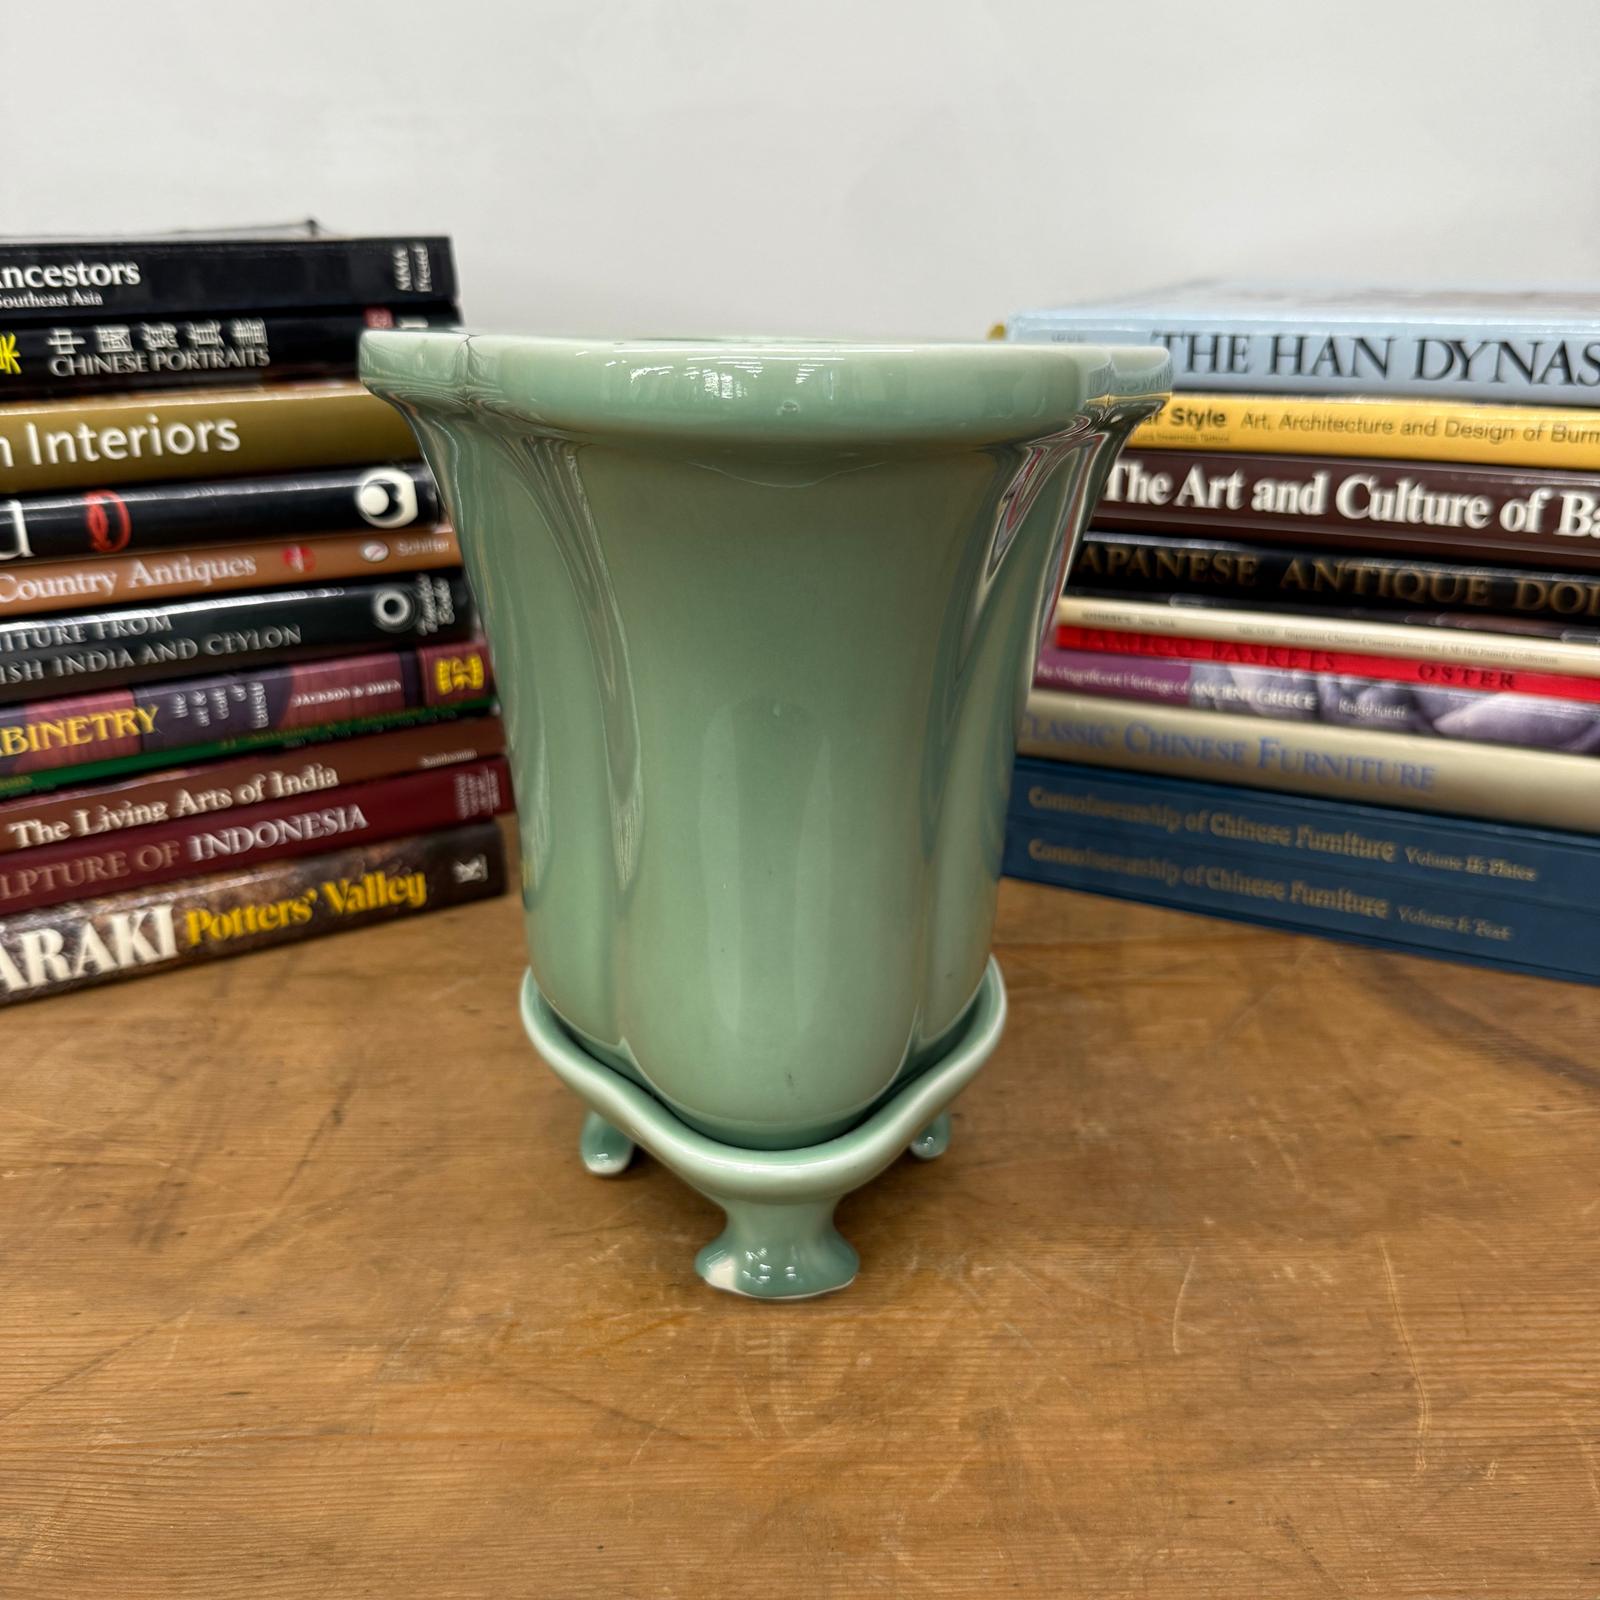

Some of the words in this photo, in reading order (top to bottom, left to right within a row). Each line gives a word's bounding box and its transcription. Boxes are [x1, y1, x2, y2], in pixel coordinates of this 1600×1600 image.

[72, 288, 104, 306] Asia
[48, 351, 149, 377] CHINESE
[151, 346, 270, 373] PORTRAITS
[1267, 333, 1396, 379] HAN
[25, 412, 241, 465] Interiors
[1171, 408, 1227, 431] Style
[1240, 410, 1271, 431] Art,
[1279, 412, 1394, 435] Architecture
[1400, 416, 1437, 437] and
[1444, 420, 1515, 445] Design
[1522, 425, 1543, 442] of
[1105, 459, 1174, 506] The
[1174, 463, 1246, 511] Art
[1251, 468, 1331, 516] and
[1335, 473, 1492, 530] Culture
[1499, 486, 1553, 534] of
[0, 569, 117, 602] Country
[128, 555, 257, 588] Antiques
[1280, 557, 1492, 605] ANTIQUE
[50, 648, 137, 677] INDIA
[141, 637, 199, 664] AND
[205, 624, 301, 656] CEYLON
[92, 615, 173, 640] FROM
[1256, 689, 1317, 711] GREECE
[1417, 663, 1515, 689] OSTER
[0, 703, 160, 757] BINETRY
[1024, 711, 1115, 748] LASSIC
[1124, 719, 1247, 762] CHINESE
[1257, 736, 1437, 791] FURNITURE
[9, 818, 71, 848] The
[73, 800, 168, 838] Living
[175, 789, 233, 818] Arts
[238, 773, 266, 805] of
[270, 763, 339, 797] India
[137, 840, 181, 873] OF
[187, 803, 369, 861] INDONESIA
[1184, 809, 1209, 832] of
[1209, 812, 1291, 847] Chinese
[1296, 824, 1396, 863] Furniture
[1404, 846, 1462, 871] Volume
[186, 888, 317, 947] Potters'
[323, 871, 427, 915] Valley
[1182, 864, 1207, 887] of
[1206, 867, 1286, 902] Chinese
[1290, 880, 1389, 920] Furniture
[1398, 904, 1456, 930] Volume
